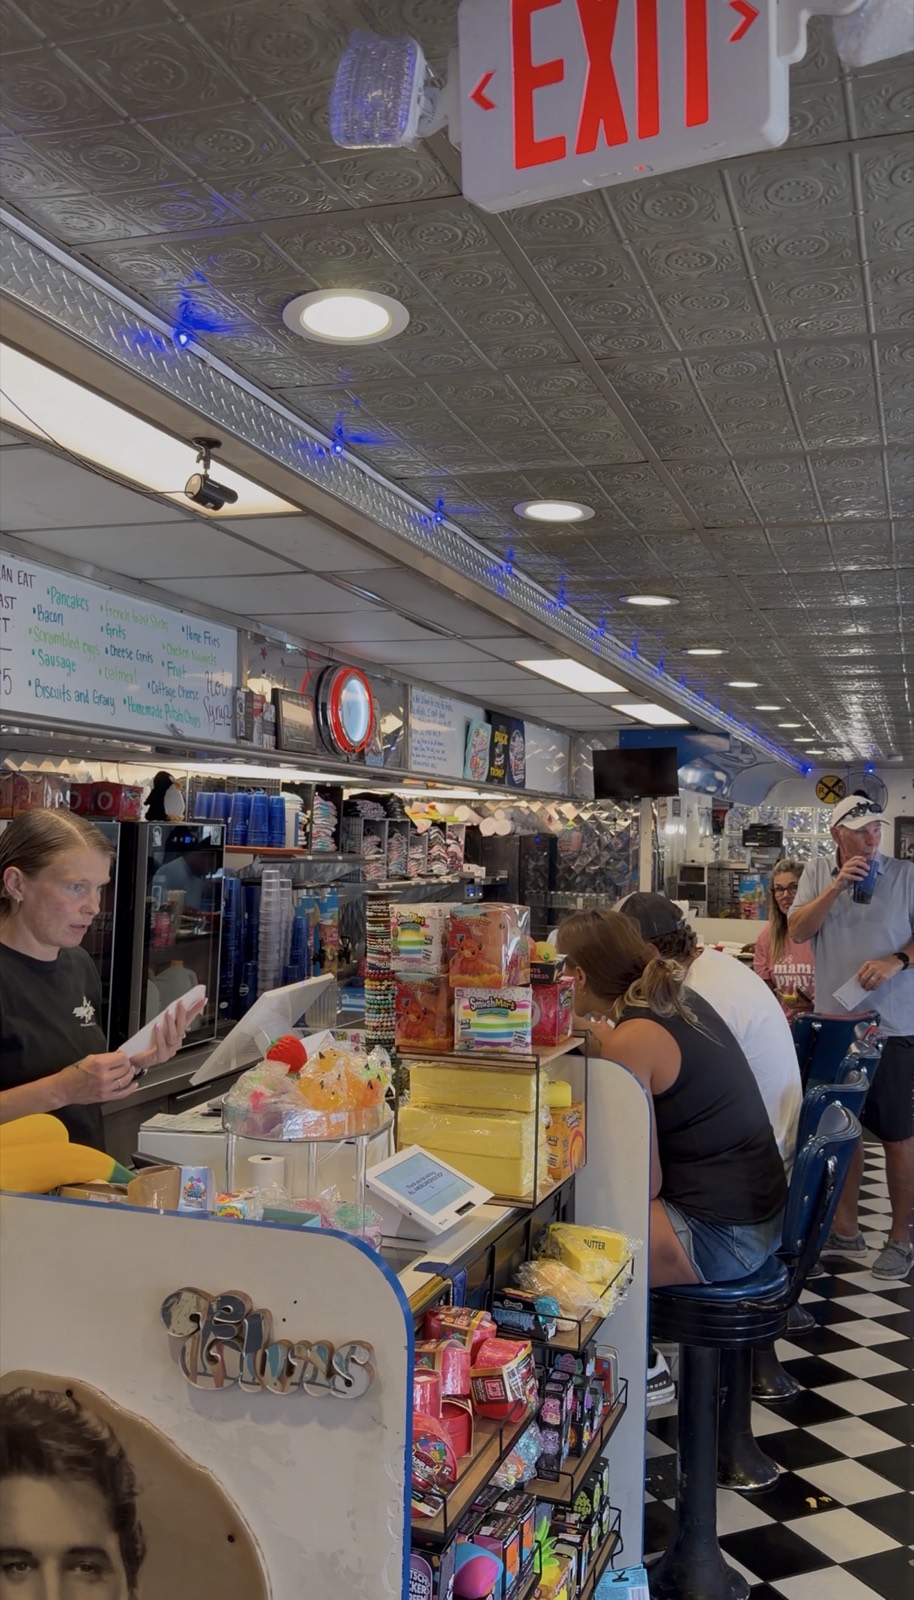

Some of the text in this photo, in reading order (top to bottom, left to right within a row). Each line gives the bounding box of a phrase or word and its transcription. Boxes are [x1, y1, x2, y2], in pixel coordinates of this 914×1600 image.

[0, 564, 37, 588] AN EAT
[50, 586, 89, 611] Pancakes
[37, 604, 64, 626] Bacon
[105, 622, 127, 640] Grits
[186, 625, 220, 648] Home Fries
[33, 626, 100, 662] Scrambled eggs
[110, 644, 154, 664] Cheese Grits
[38, 648, 77, 677] Sausage
[167, 660, 187, 679] Fruit
[151, 680, 199, 702] Cottage Cheese
[205, 669, 228, 696] Hot
[34, 678, 116, 716] Biscuits and Gravy
[127, 696, 163, 719] Homemade
